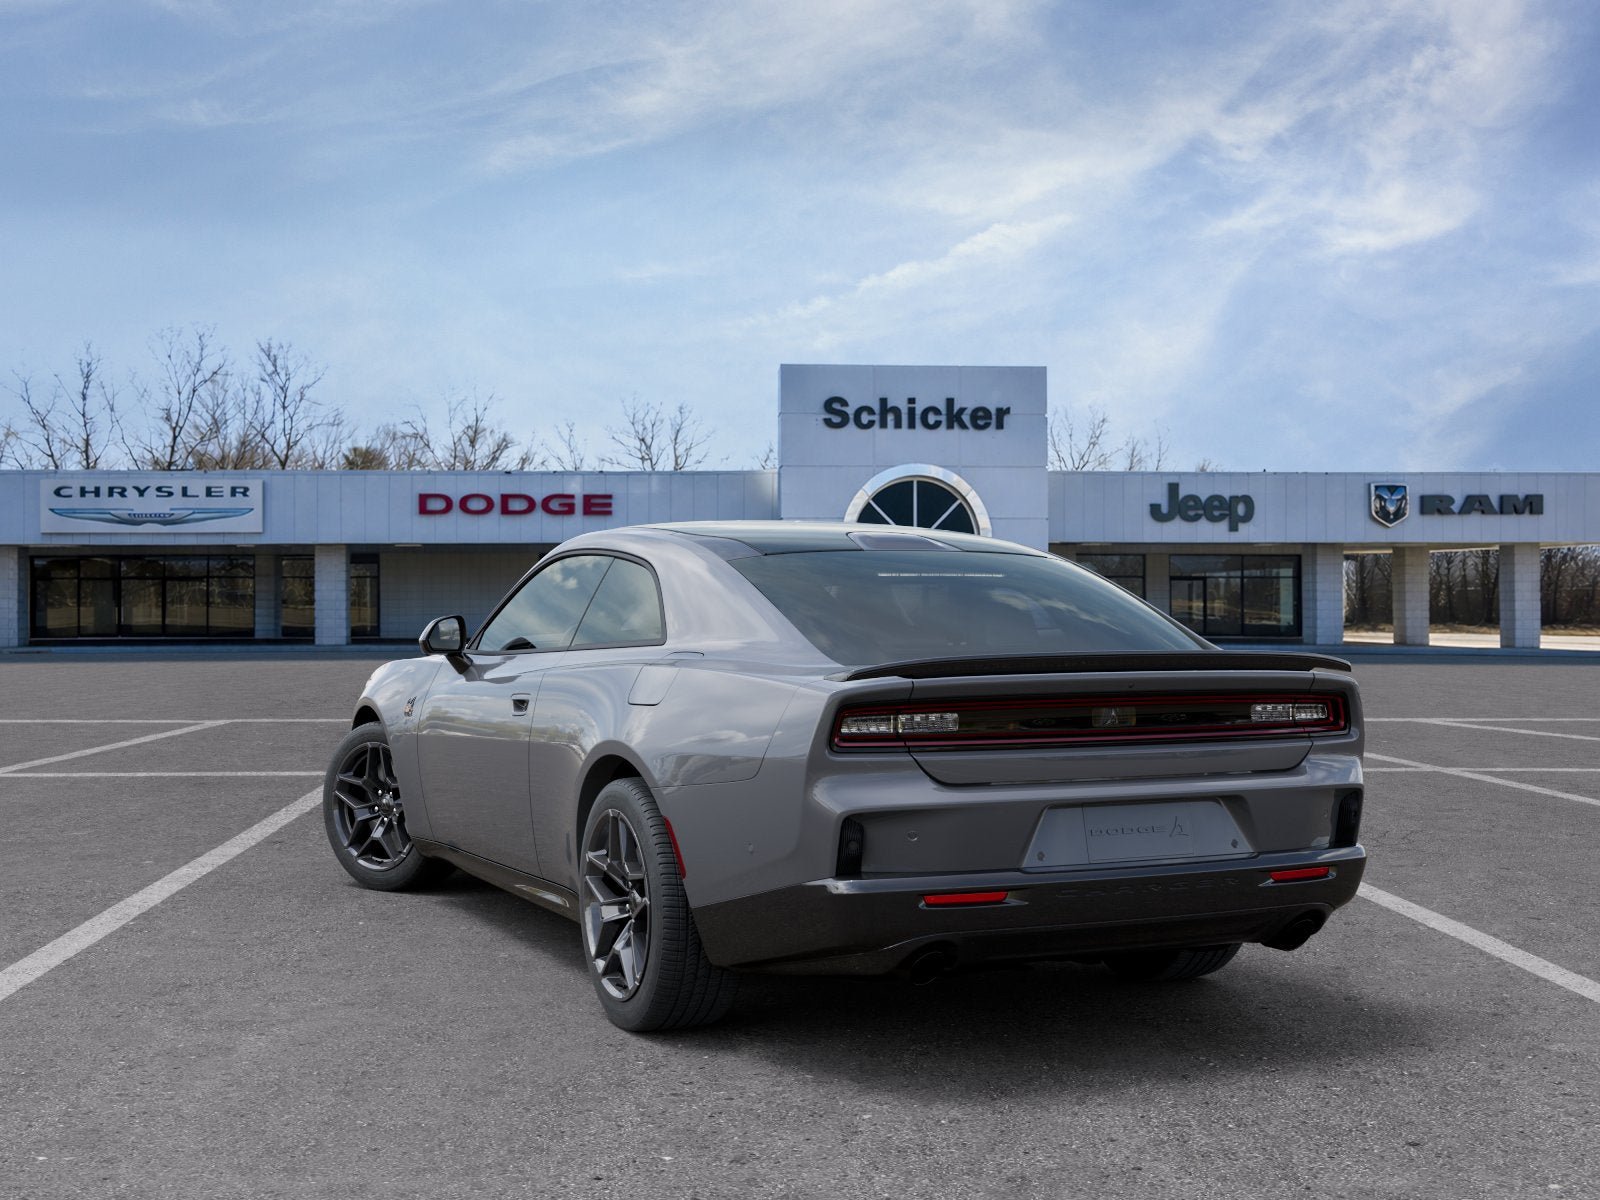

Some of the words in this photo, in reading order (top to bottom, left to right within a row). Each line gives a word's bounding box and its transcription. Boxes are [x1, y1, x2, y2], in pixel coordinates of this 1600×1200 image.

[823, 396, 1011, 430] Schicker
[53, 485, 251, 498] CHRYSLER
[418, 493, 613, 516] DODGE
[1149, 482, 1255, 532] Jeep
[1419, 494, 1545, 515] RAM
[1089, 824, 1168, 838] DODGE
